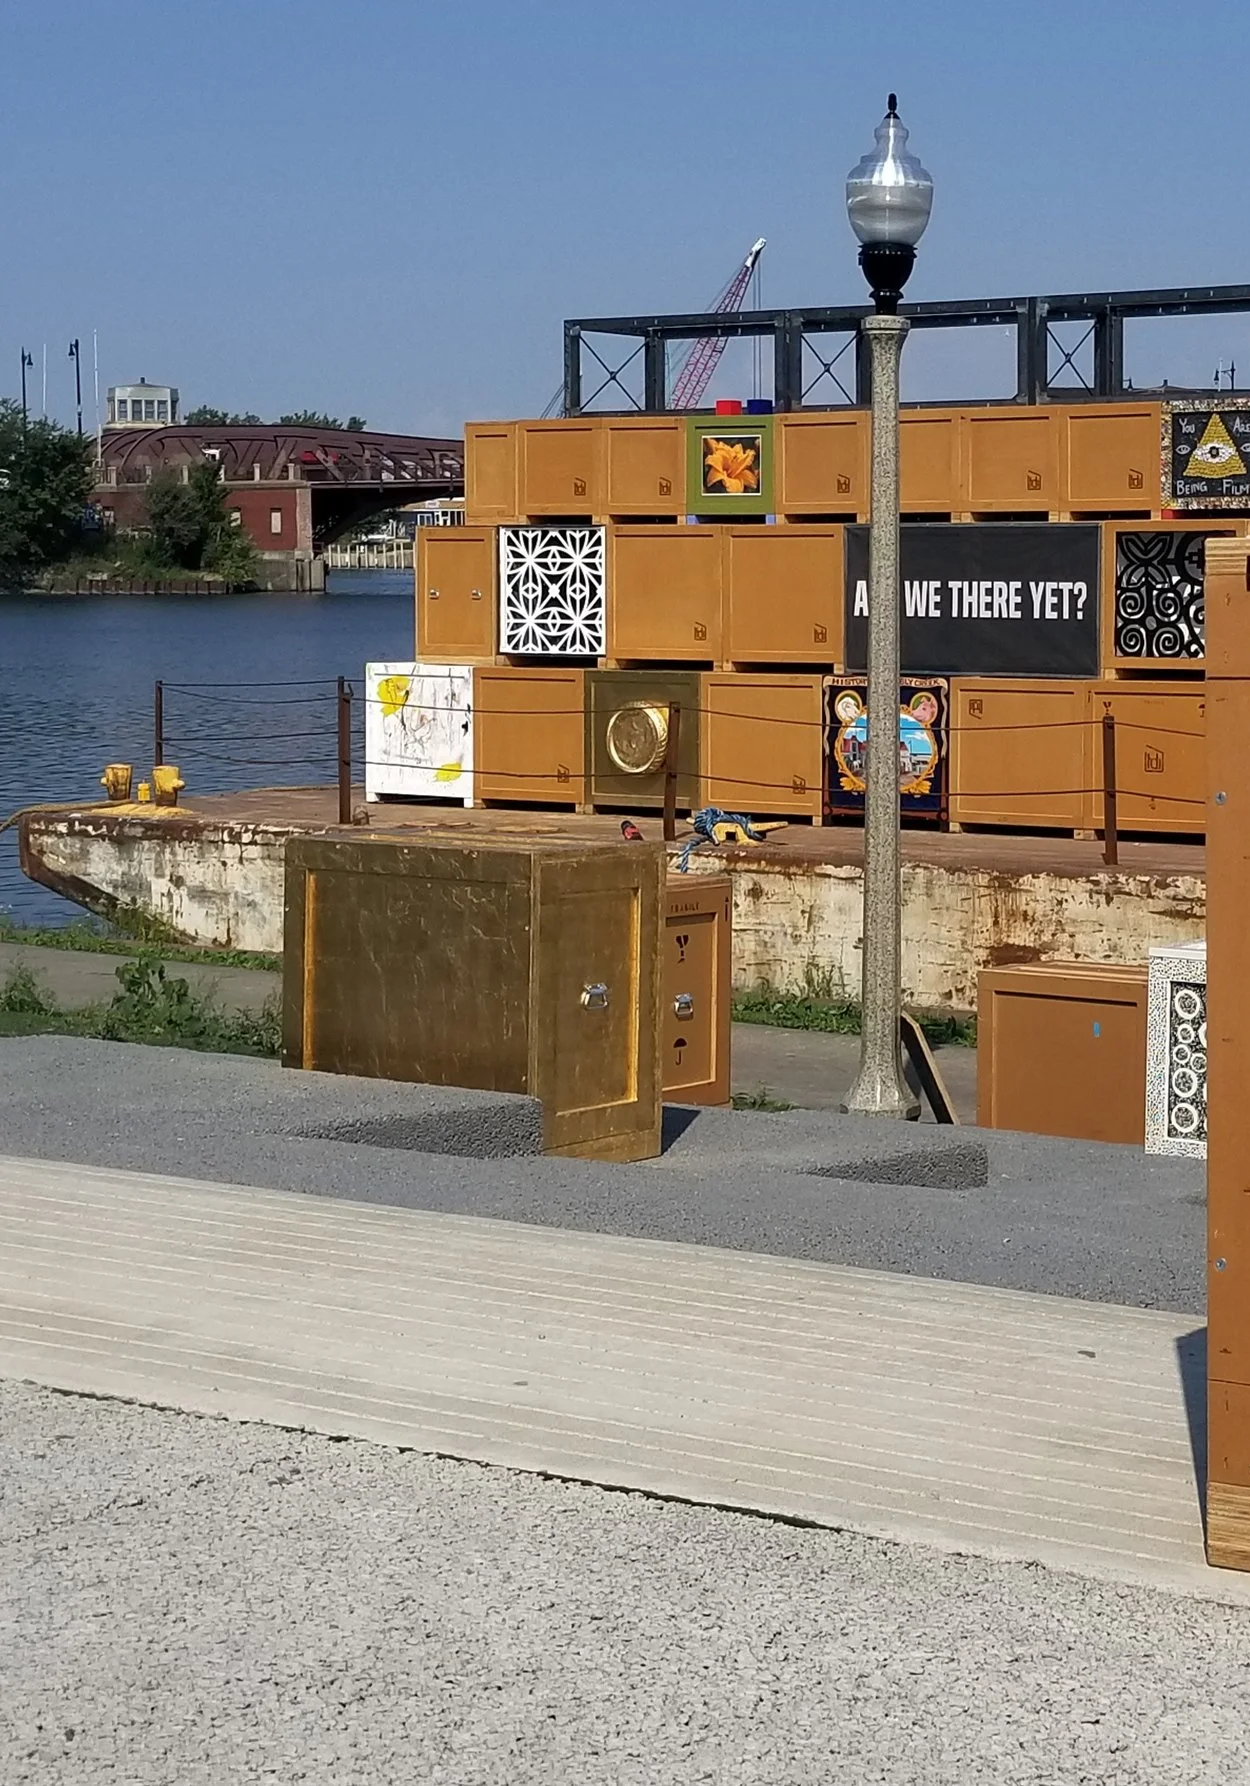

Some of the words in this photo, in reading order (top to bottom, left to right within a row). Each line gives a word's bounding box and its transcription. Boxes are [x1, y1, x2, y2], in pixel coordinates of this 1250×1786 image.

[1176, 480, 1208, 495] BEING
[904, 580, 941, 617] WE
[948, 581, 1022, 619] THERE
[1029, 581, 1087, 620] YET?
[831, 678, 868, 687] HISTOR
